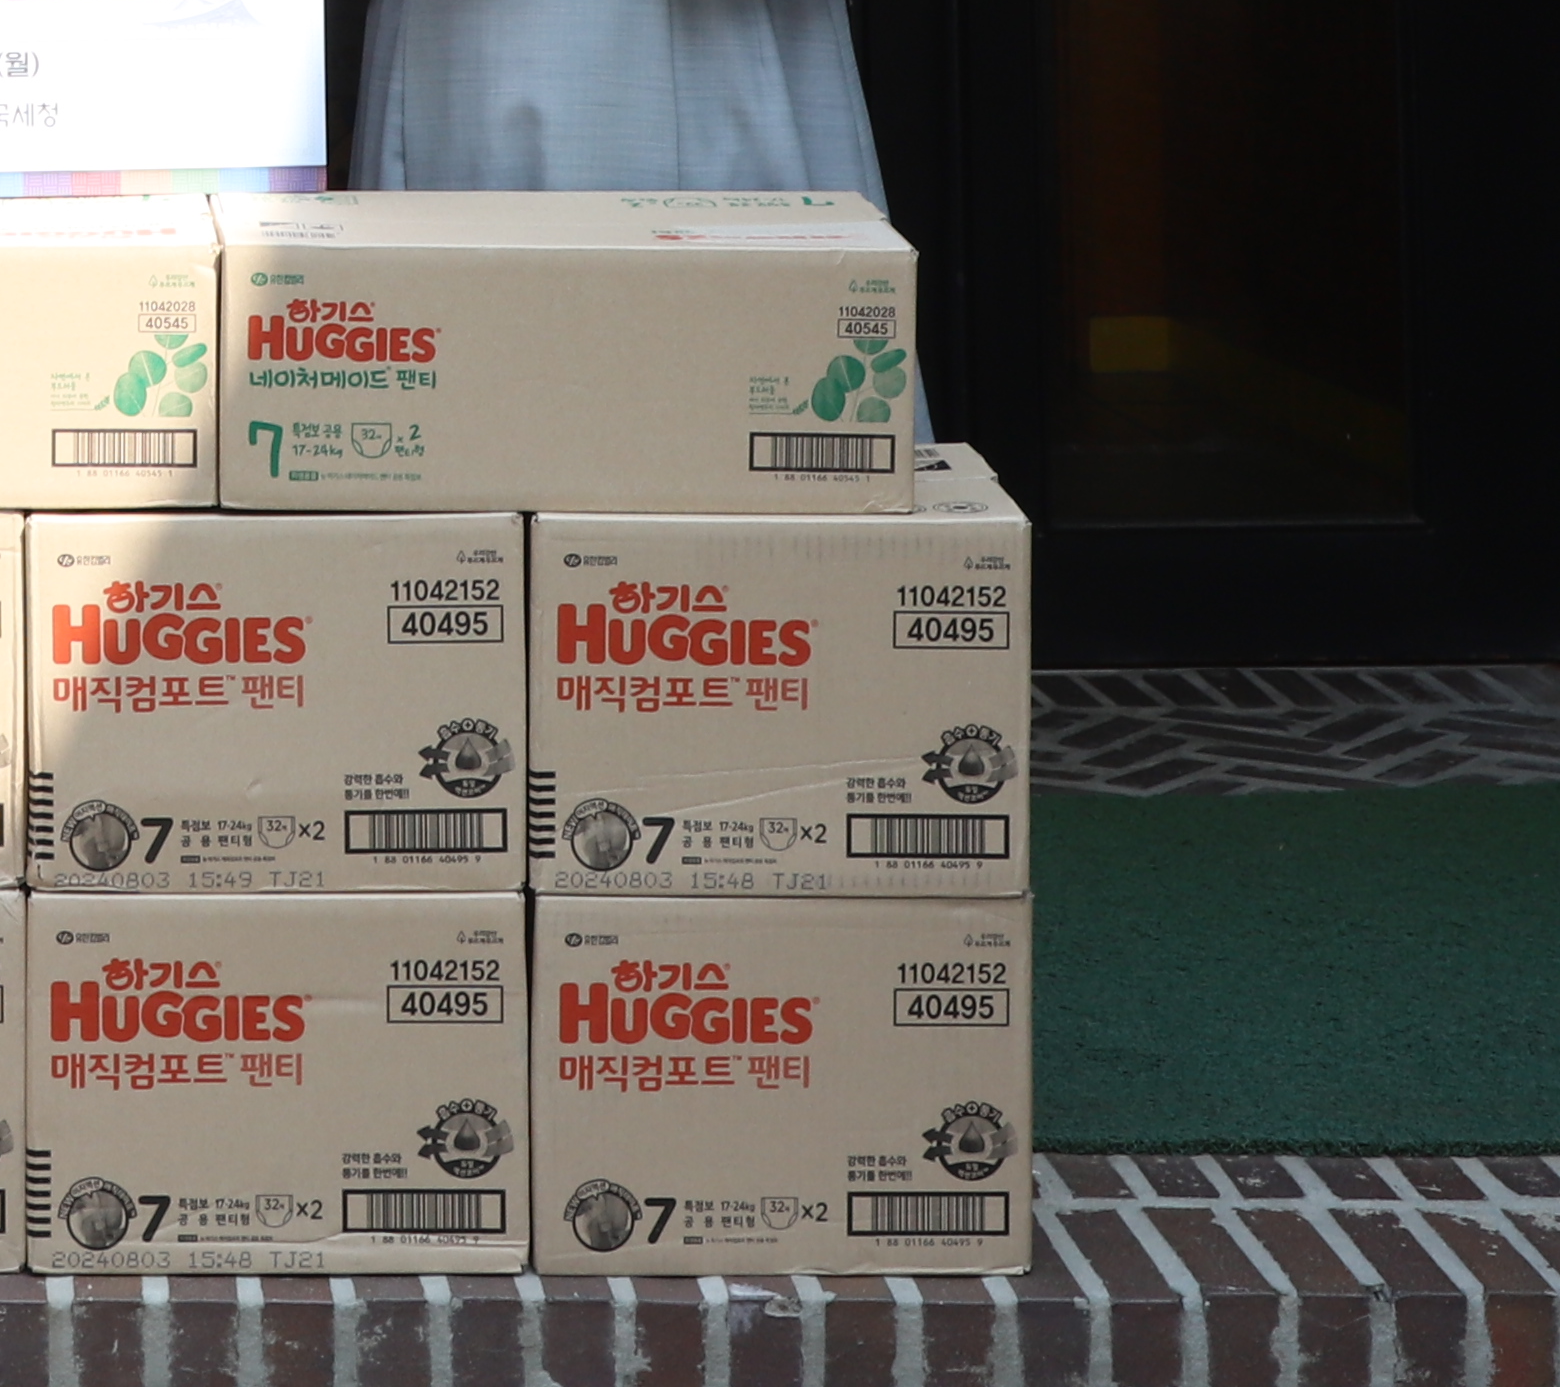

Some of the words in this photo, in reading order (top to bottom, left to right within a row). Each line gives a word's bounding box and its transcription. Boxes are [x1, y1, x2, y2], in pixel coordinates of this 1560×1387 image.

[139, 301, 195, 312] 11042028
[287, 299, 374, 323] 하기스
[839, 307, 895, 317] 11042028
[146, 317, 189, 329] 40545
[845, 322, 888, 335] 40545
[248, 315, 436, 363] HUGGIES
[249, 367, 388, 390] 네이처메이드
[396, 367, 437, 390] 팬티
[249, 421, 283, 478] 7
[103, 580, 221, 612] 하기스
[390, 580, 500, 601] 11042152
[609, 582, 727, 613] 하기스
[897, 586, 1006, 607] 11042152
[51, 603, 306, 665] HUGGIES
[401, 611, 489, 636] 40495
[557, 604, 811, 666] HUGGIES
[906, 617, 995, 642] 40495
[242, 675, 305, 708] 팬티
[746, 678, 809, 711] 팬티
[141, 818, 174, 863] 7
[642, 817, 675, 863] 7
[268, 871, 325, 888] TJ21
[555, 872, 673, 889] 20240803
[772, 873, 827, 890] TJ21
[102, 958, 220, 990] 하기스
[390, 960, 499, 981] 11042152
[611, 960, 729, 992] 하기스
[898, 963, 1006, 985] 11042152
[50, 980, 305, 1042] HUGGIES
[400, 991, 488, 1016] 40495
[559, 983, 812, 1045] HUGGIES
[907, 994, 994, 1019] 40495
[241, 1054, 304, 1087] 팬티
[748, 1056, 810, 1089] 팬티
[138, 1195, 171, 1241] 7
[644, 1197, 676, 1243] 7
[51, 1252, 170, 1269] 20240803
[269, 1251, 325, 1268] TJ21
